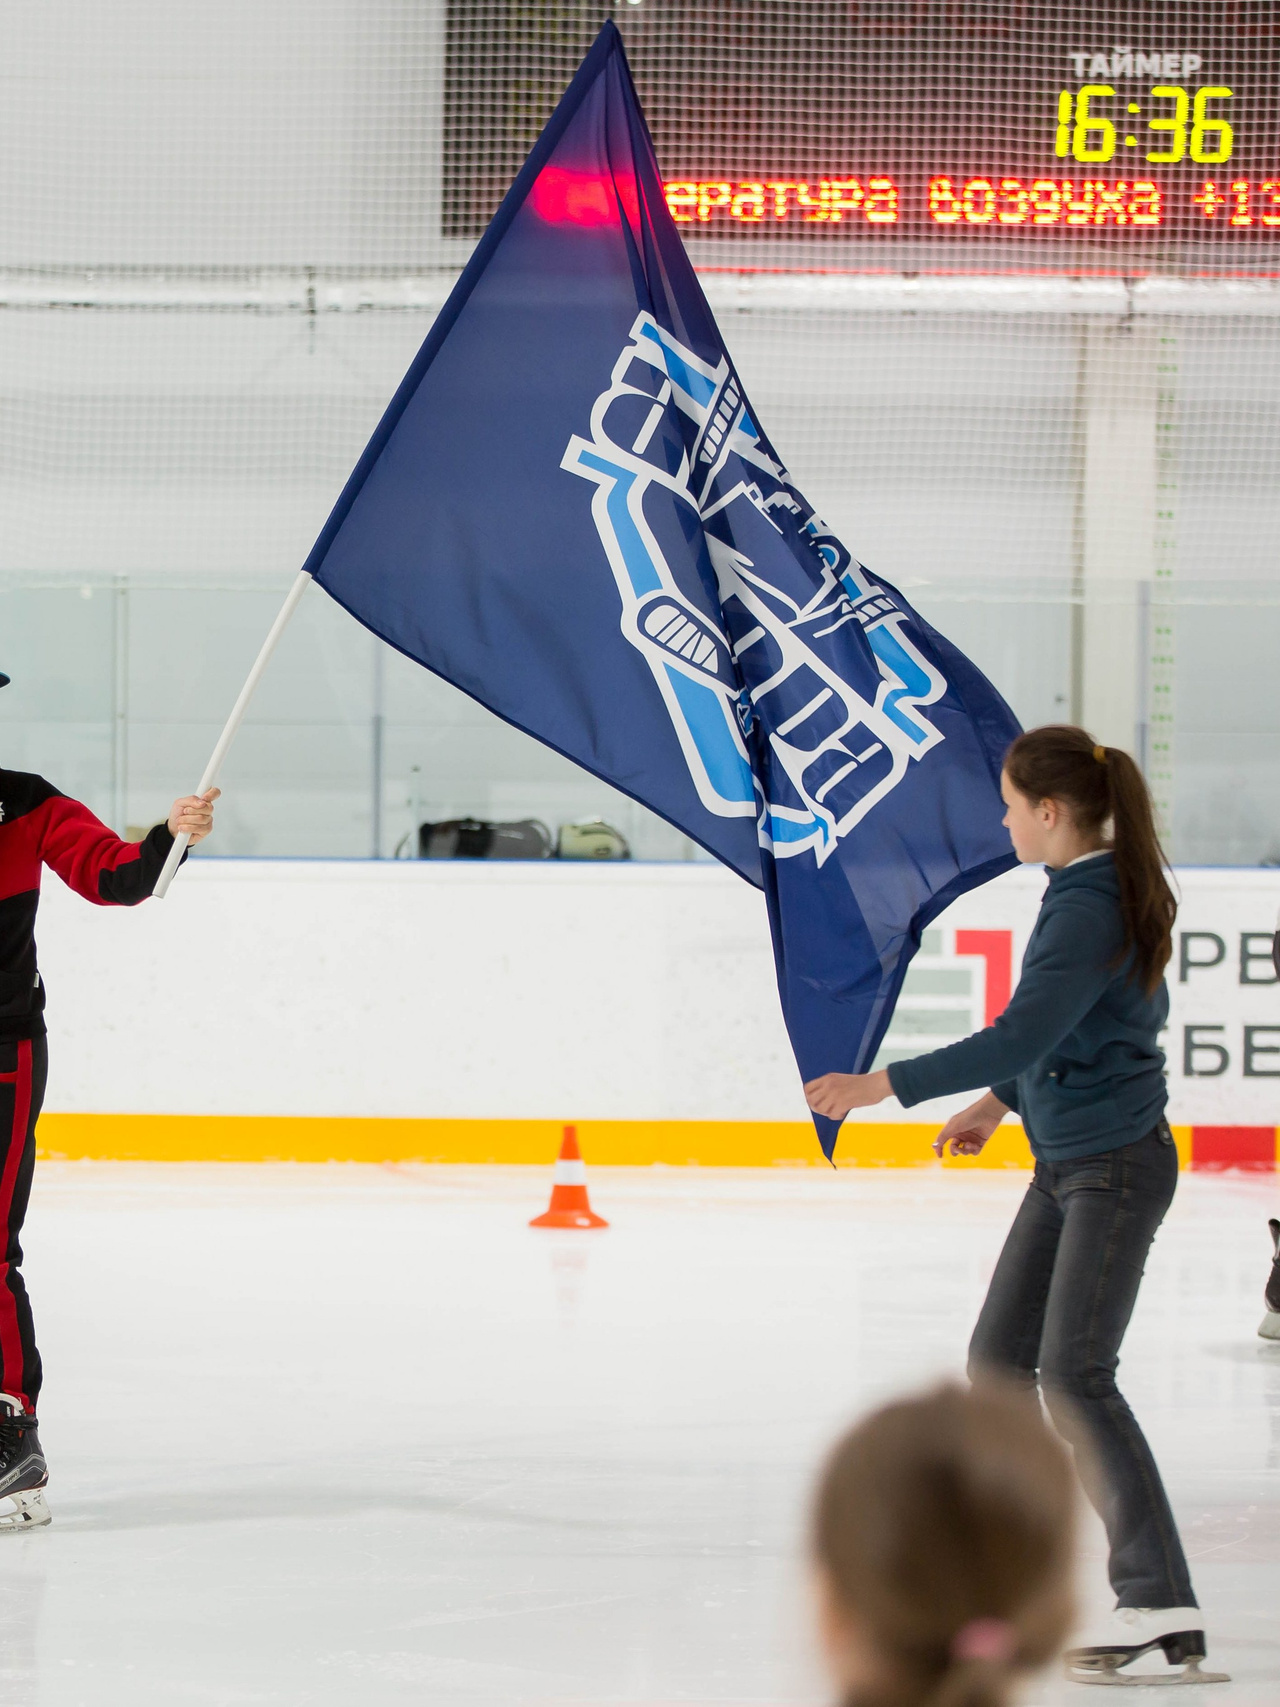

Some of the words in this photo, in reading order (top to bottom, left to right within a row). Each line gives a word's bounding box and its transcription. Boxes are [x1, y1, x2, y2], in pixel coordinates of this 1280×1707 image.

[1069, 46, 1202, 79] ТАЙМЕР
[1055, 85, 1234, 163] 16:36
[1160, 1024, 1280, 1077] БЕ
